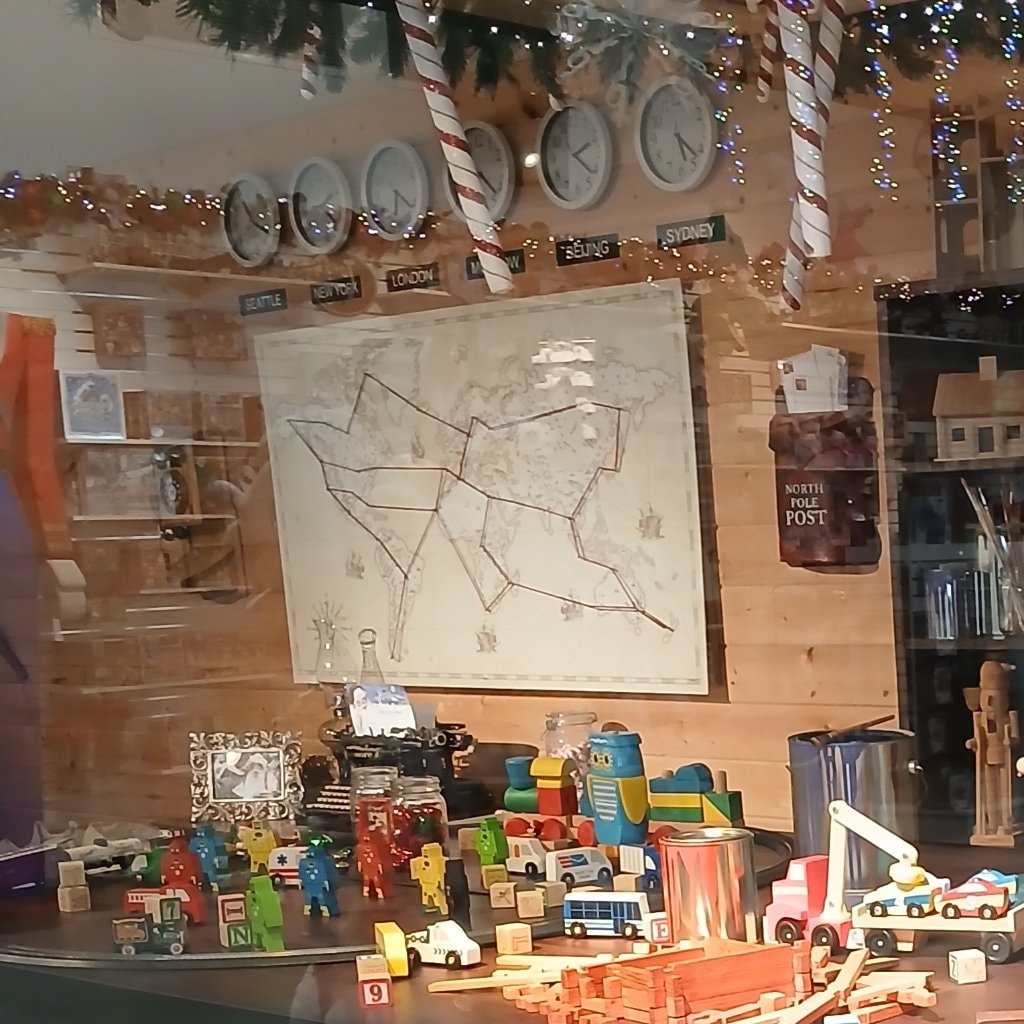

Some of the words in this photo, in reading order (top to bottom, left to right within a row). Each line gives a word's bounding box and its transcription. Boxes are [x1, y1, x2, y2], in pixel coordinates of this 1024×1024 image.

[666, 222, 716, 243] SYDNEY
[566, 240, 610, 260] BEIJING
[391, 269, 434, 287] LONDON
[313, 285, 333, 299] NEW
[333, 281, 359, 297] YORK
[246, 294, 282, 311] SEATTLE
[785, 483, 824, 495] NORTH
[790, 497, 820, 509] POLE
[785, 509, 828, 526] POST
[233, 926, 250, 945] N
[655, 923, 668, 938] E
[368, 984, 383, 1004] 9
